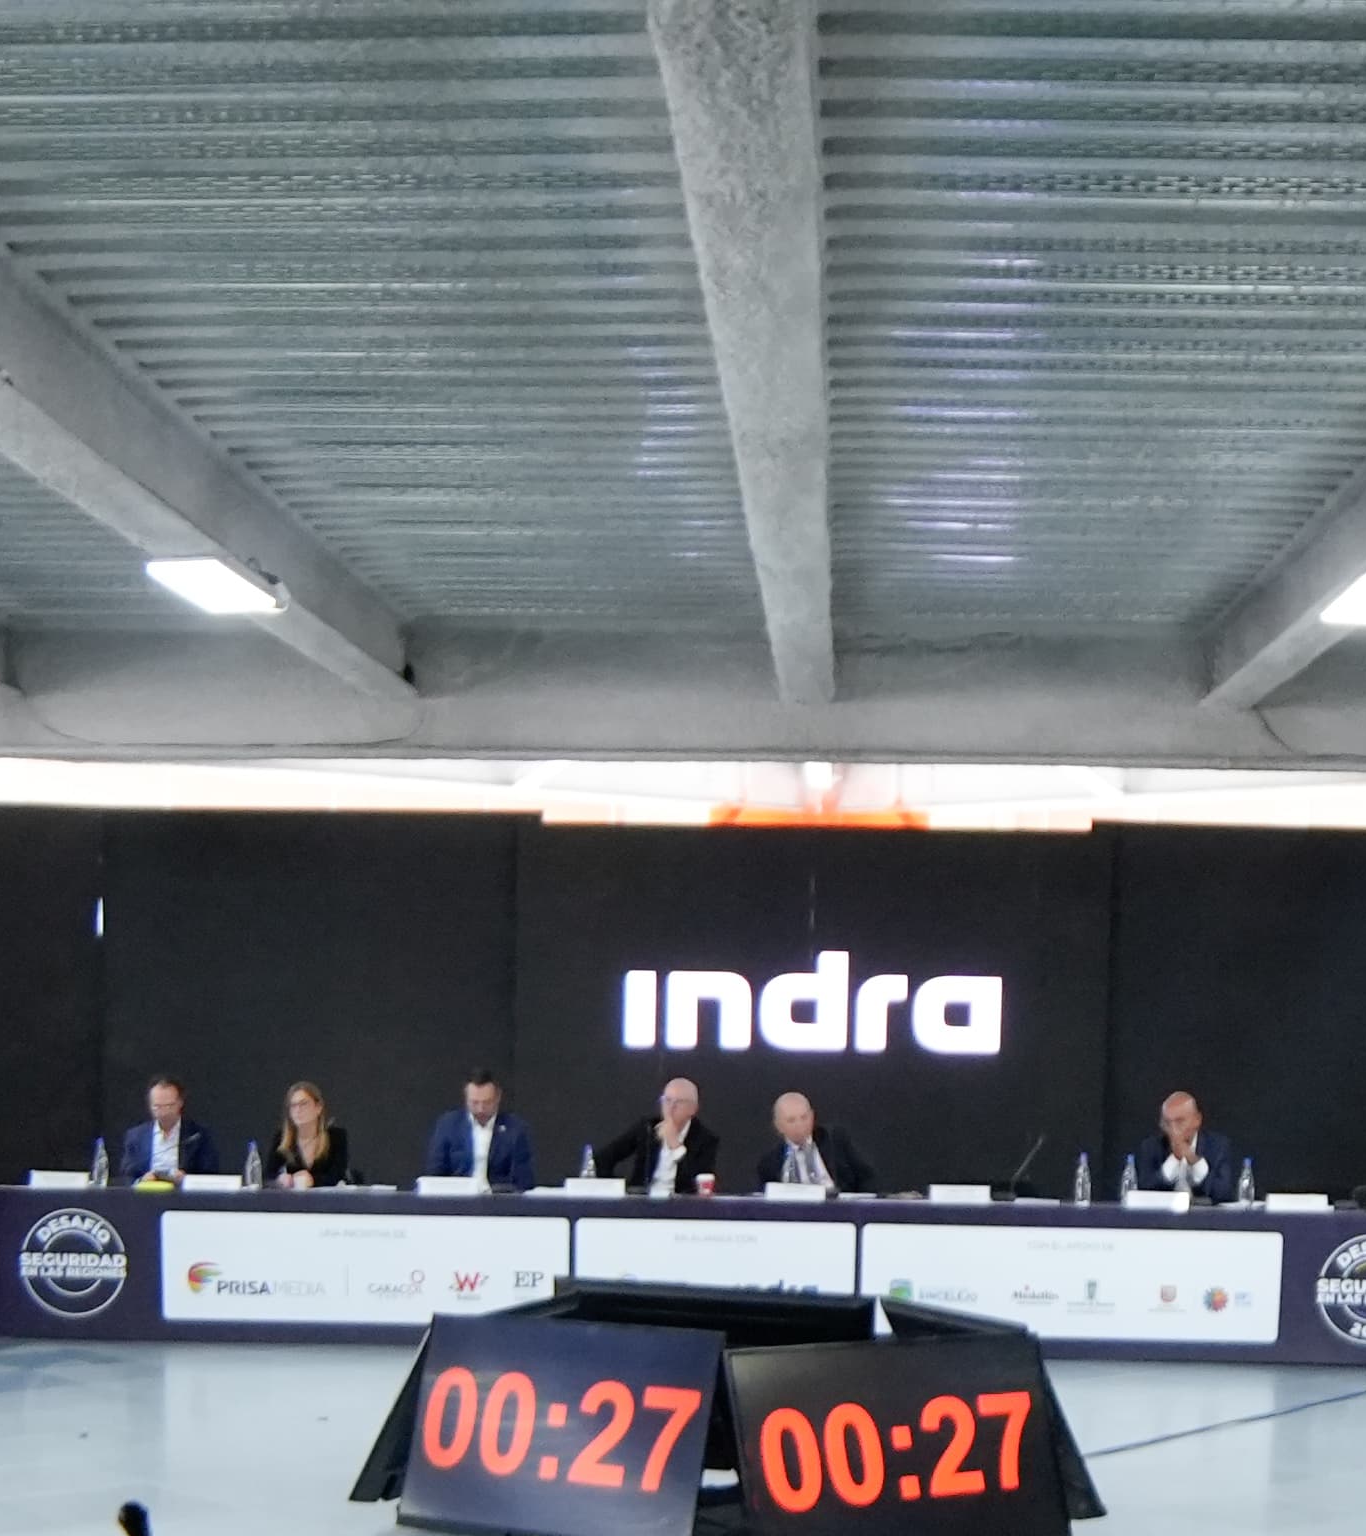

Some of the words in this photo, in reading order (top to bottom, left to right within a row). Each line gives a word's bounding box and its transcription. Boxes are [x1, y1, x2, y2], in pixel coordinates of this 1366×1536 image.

[622, 949, 1003, 1056] indra
[37, 1215, 111, 1245] DESAFÍO
[20, 1252, 128, 1267] SEGURIDAD
[21, 1266, 39, 1277] EN
[41, 1266, 63, 1277] LAS
[514, 1271, 545, 1289] EP
[216, 1279, 271, 1296] PRISA
[1317, 1294, 1335, 1305] EN
[1337, 1293, 1362, 1305] LAS
[423, 1366, 702, 1493] 00:27
[760, 1391, 1031, 1514] 00:27
